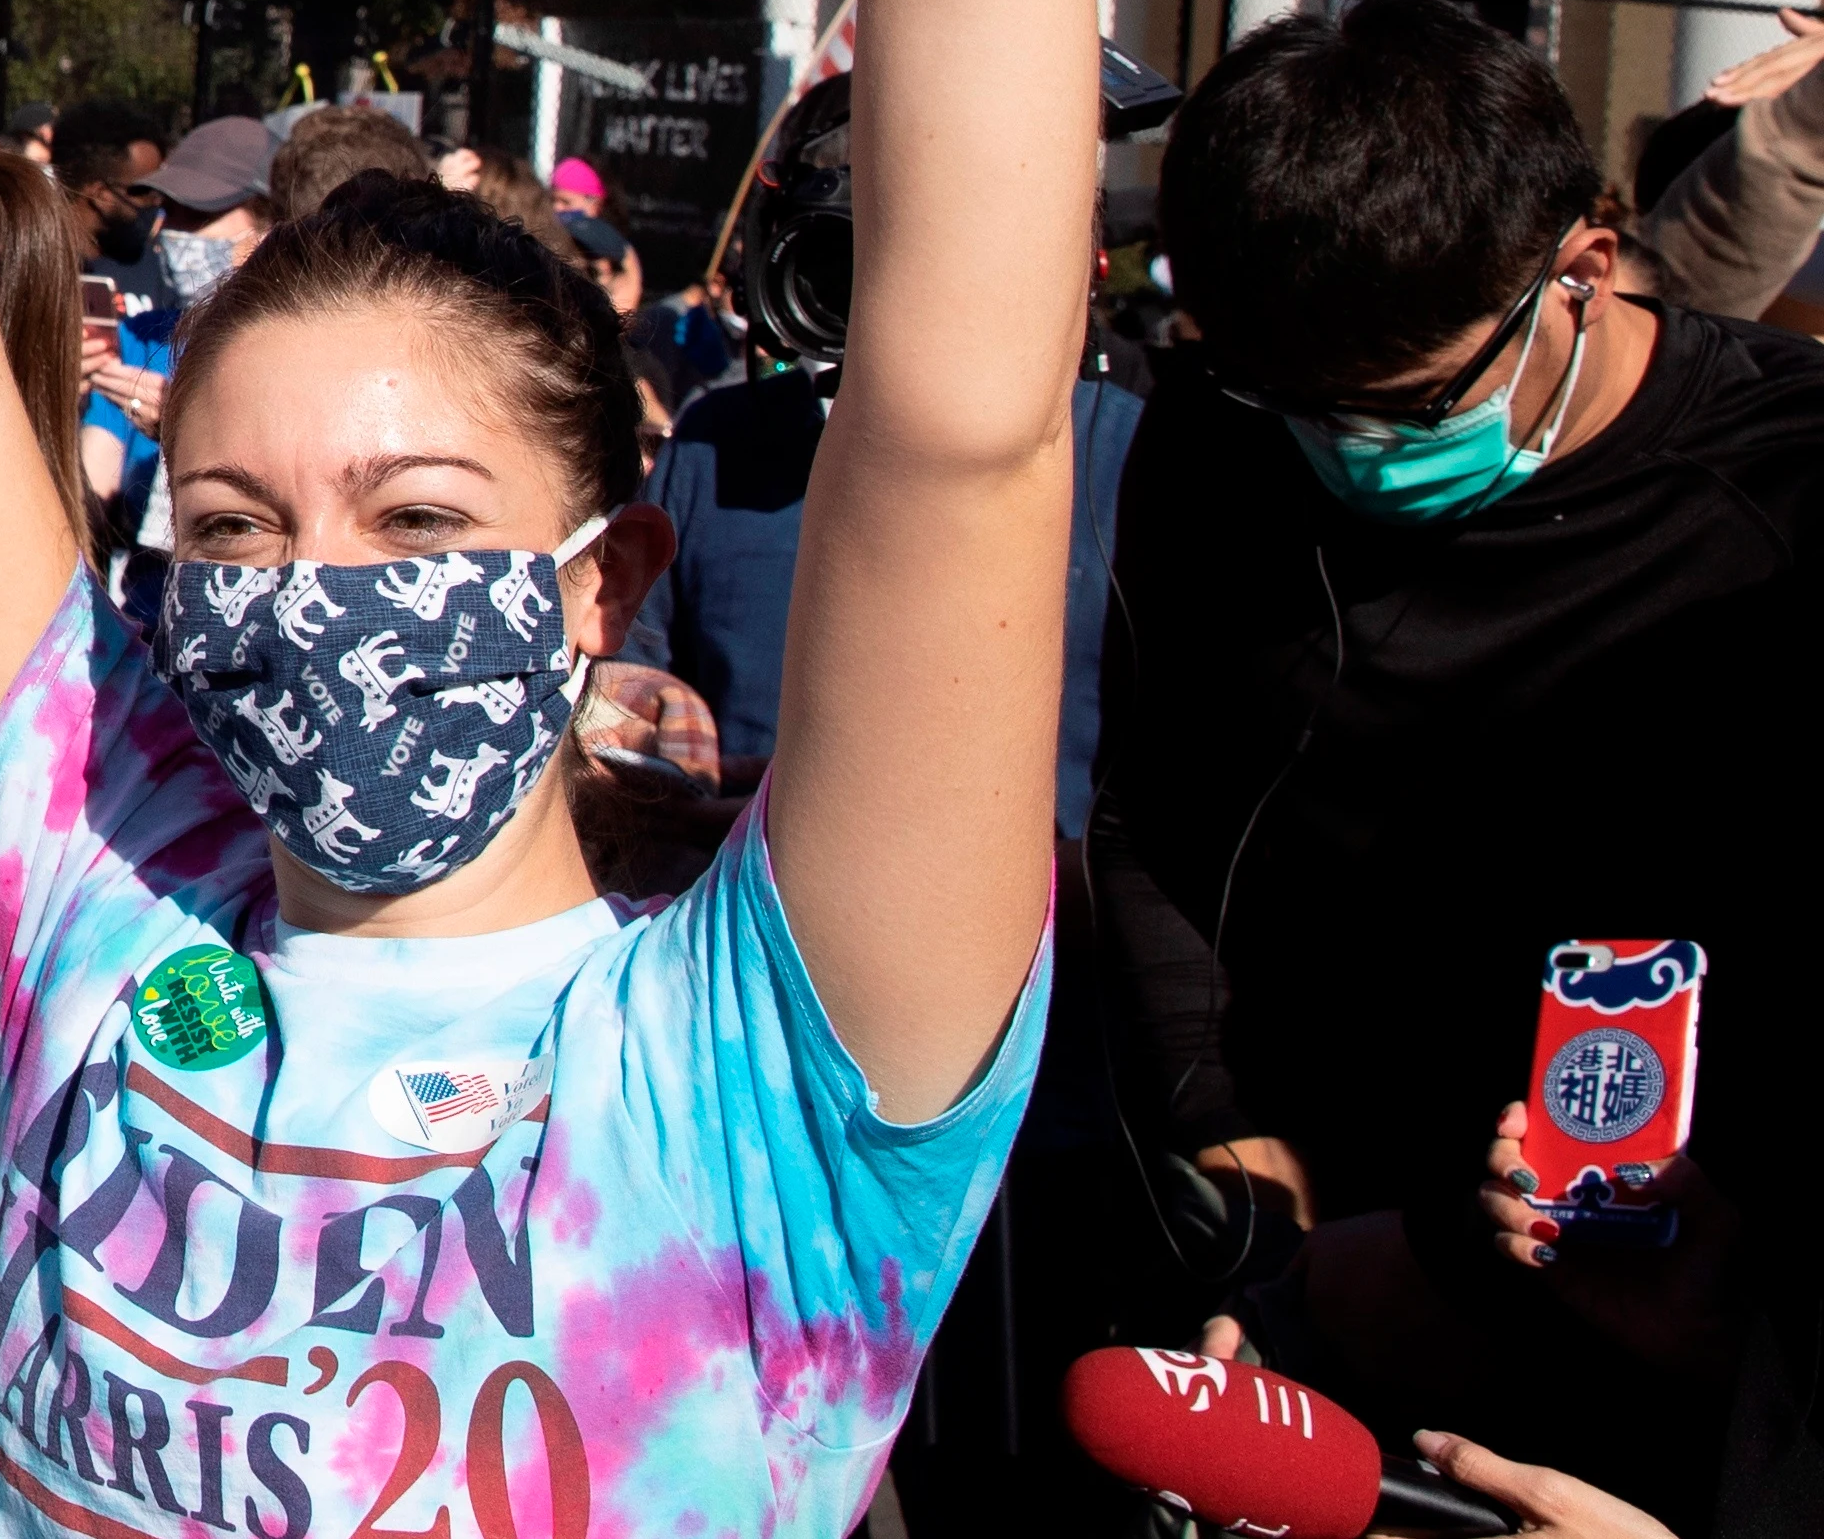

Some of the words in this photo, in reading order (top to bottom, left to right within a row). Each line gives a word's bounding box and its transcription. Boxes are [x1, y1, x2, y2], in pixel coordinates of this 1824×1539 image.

[439, 612, 477, 674] VOTE
[302, 664, 344, 726] VOTE
[381, 716, 425, 777] VOTE
[138, 999, 170, 1046] love
[167, 977, 218, 1055] RESIST
[208, 959, 245, 1004] Unite
[230, 1006, 266, 1039] with
[157, 1000, 199, 1065] WITH
